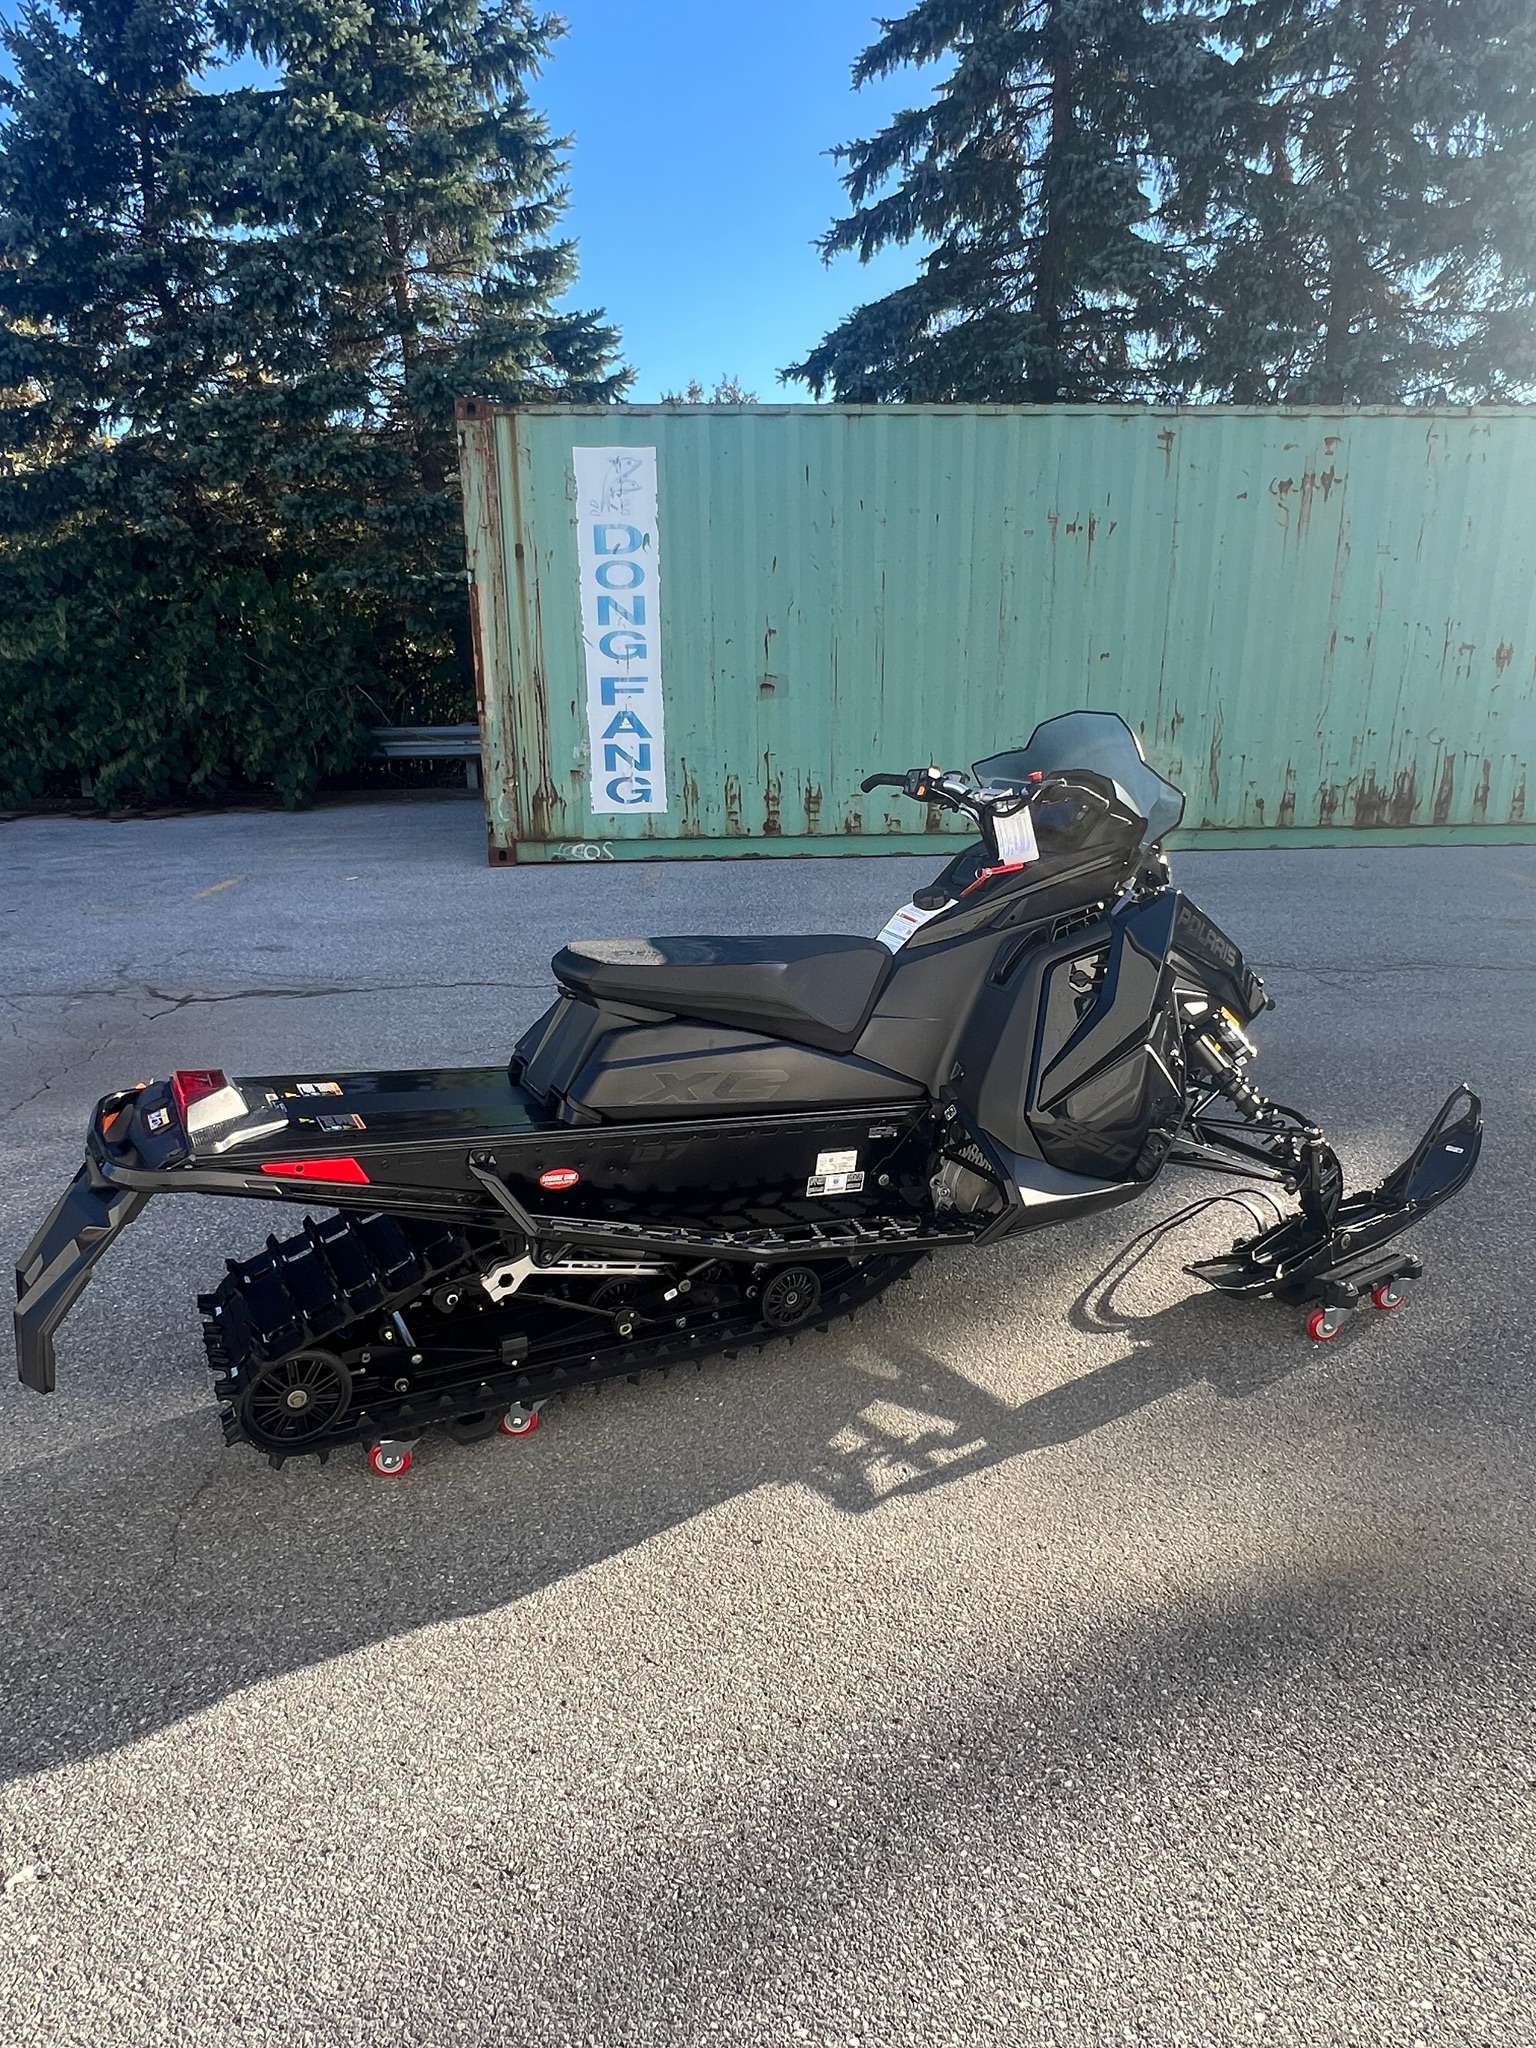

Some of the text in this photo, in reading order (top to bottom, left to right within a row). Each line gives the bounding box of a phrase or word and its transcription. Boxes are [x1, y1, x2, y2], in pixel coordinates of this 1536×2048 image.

[593, 523, 653, 805] DONG FANG
[1176, 906, 1237, 968] POLARIS
